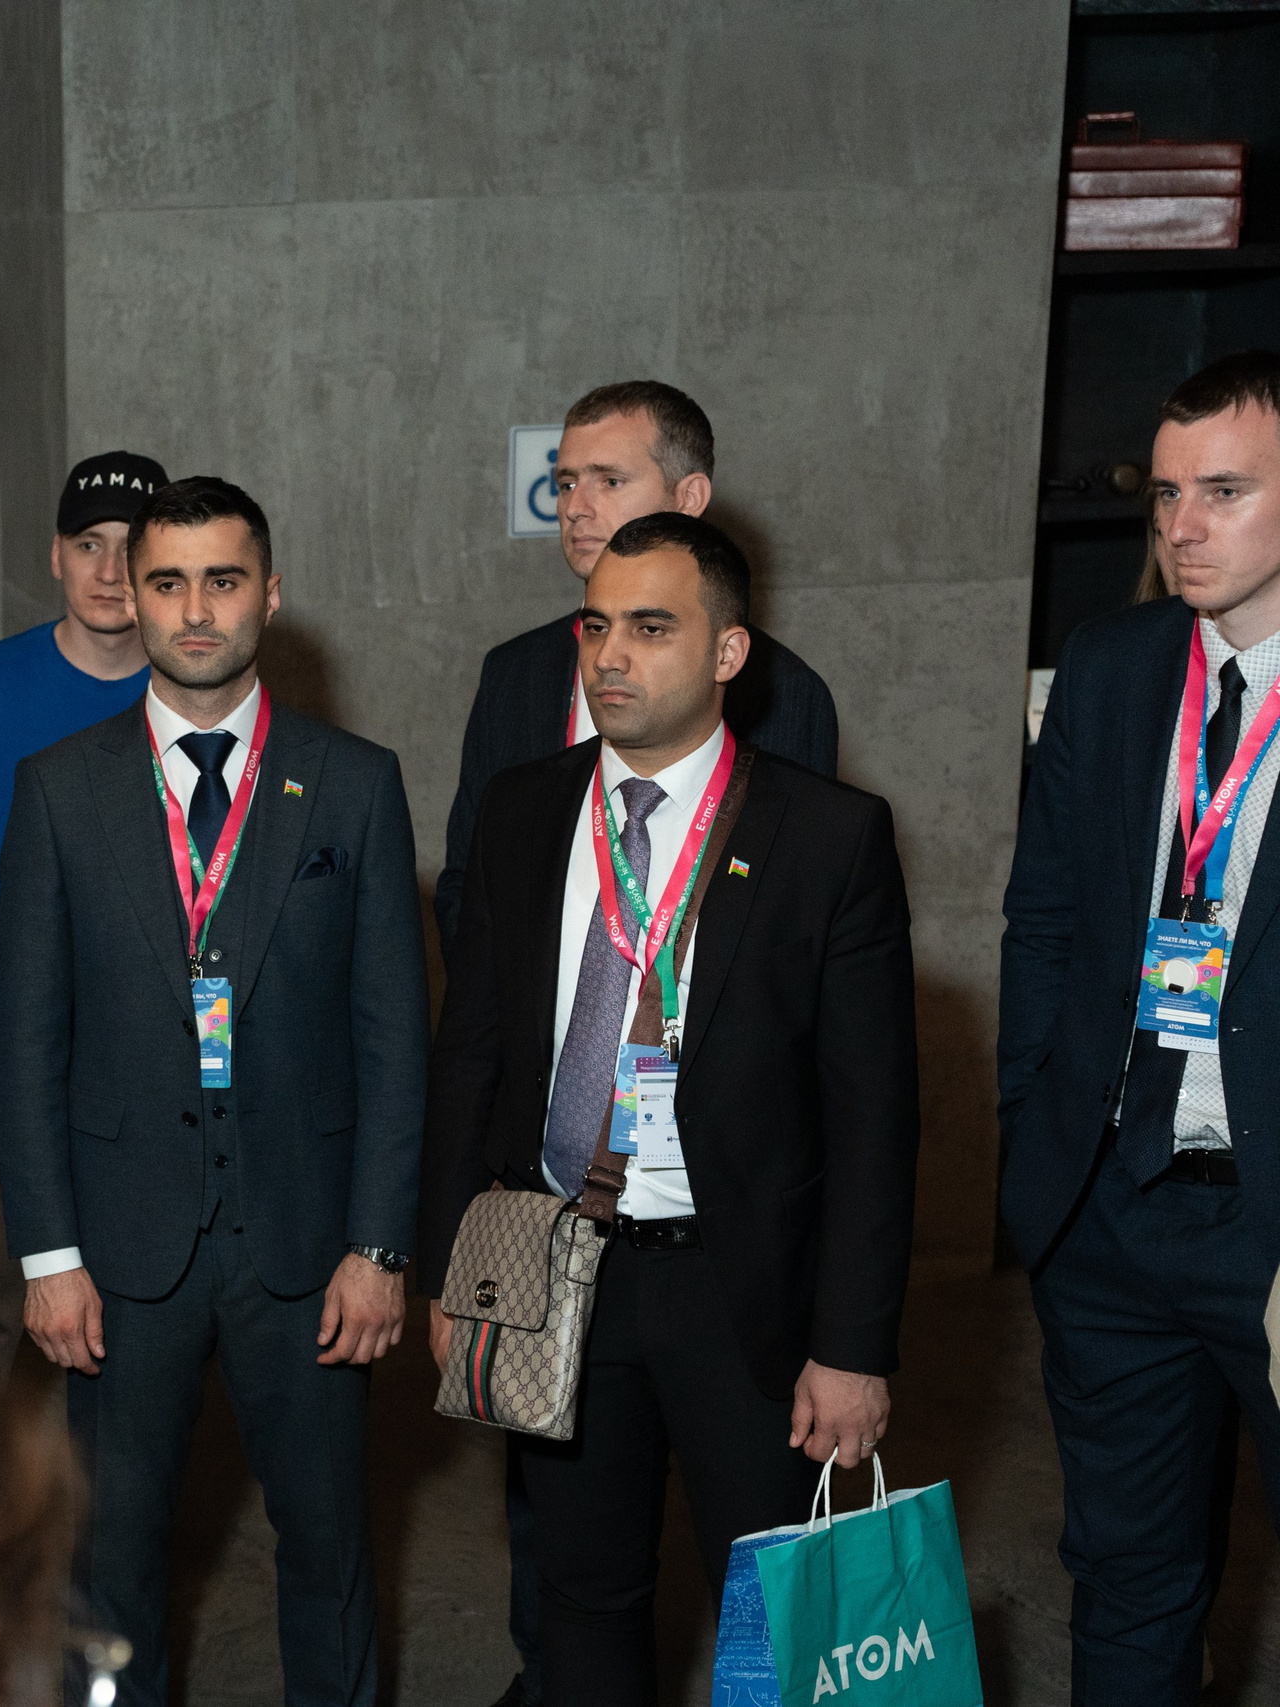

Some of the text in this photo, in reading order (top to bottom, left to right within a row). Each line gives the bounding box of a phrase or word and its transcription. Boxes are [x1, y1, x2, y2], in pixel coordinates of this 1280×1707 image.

[245, 749, 259, 782] ATOM
[1213, 777, 1238, 814] ATOM
[594, 804, 603, 837] ATOM
[208, 852, 227, 884] ATOM
[631, 888, 647, 913] CASE-IN
[609, 914, 627, 948] ATOM
[813, 1618, 935, 1705] ATOM
